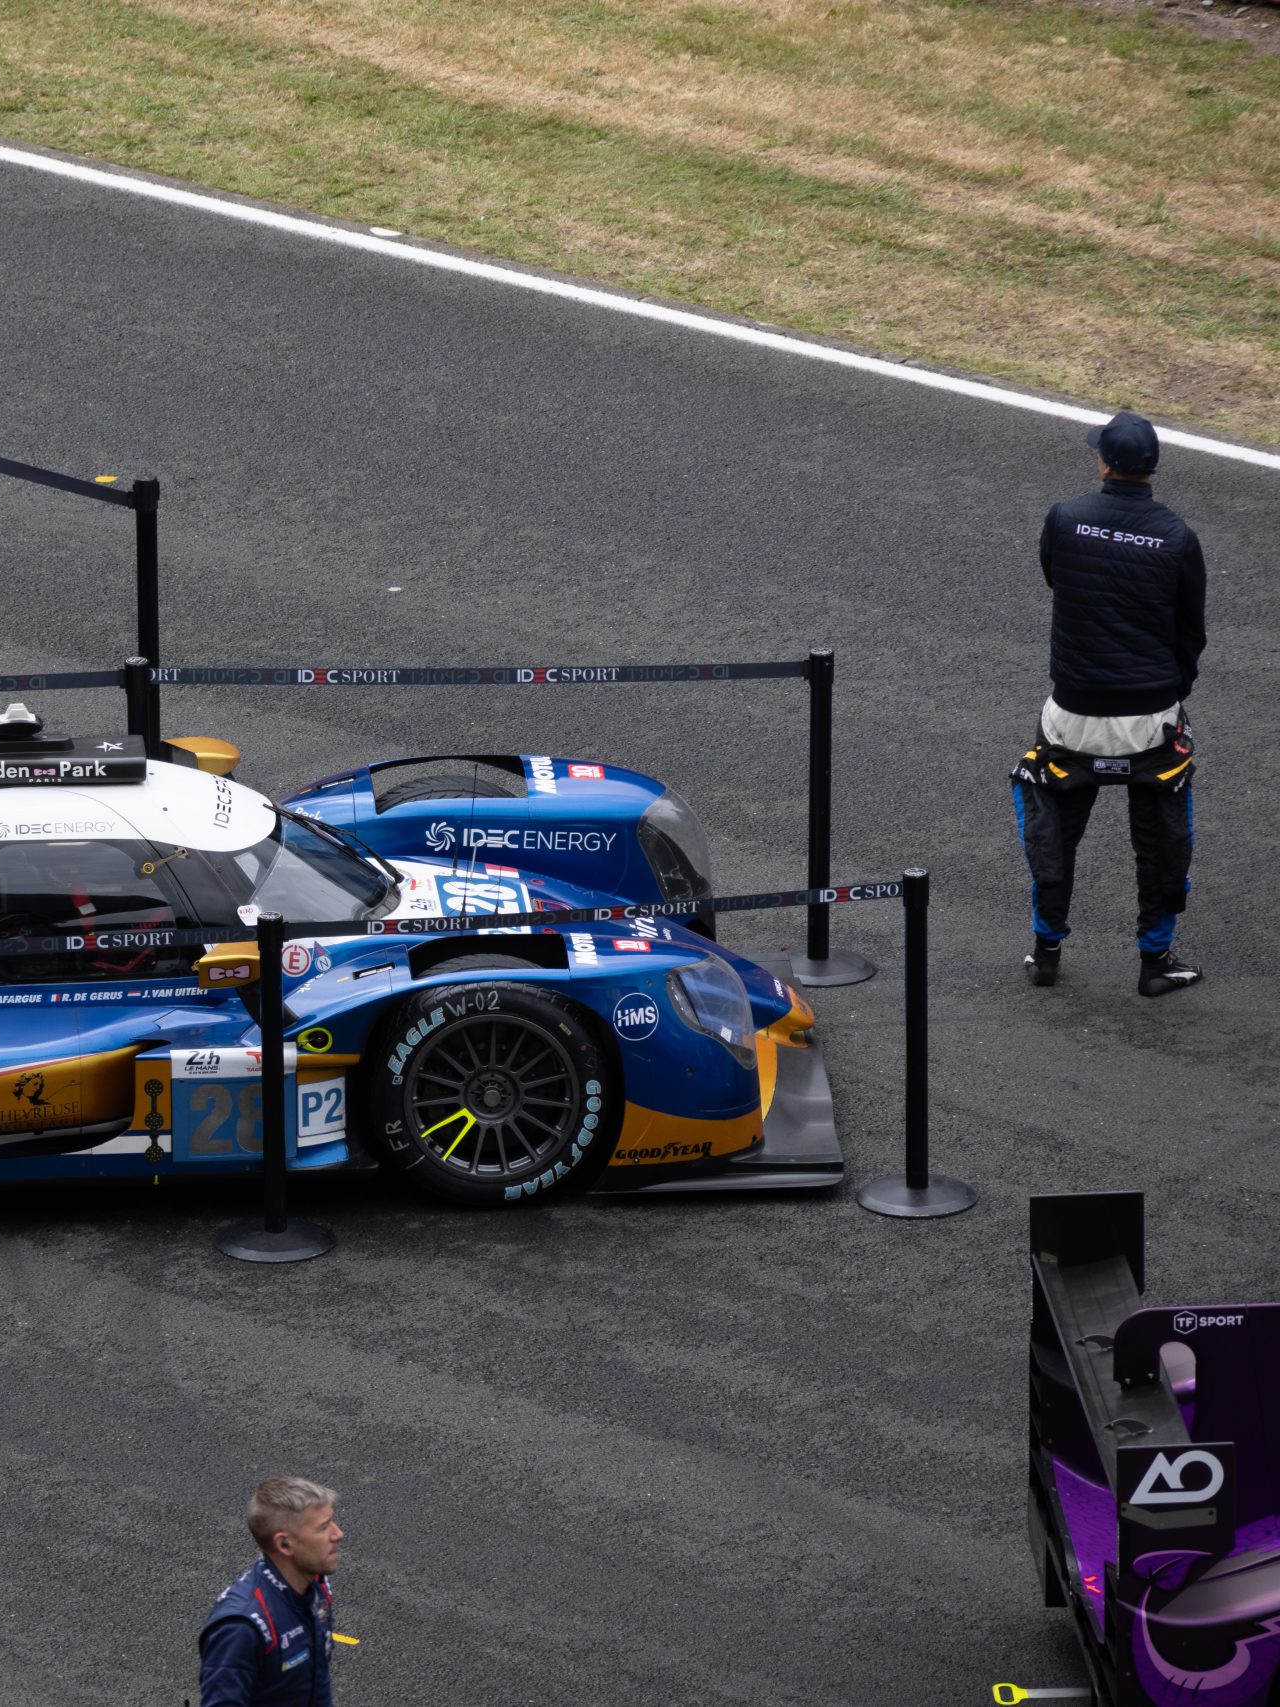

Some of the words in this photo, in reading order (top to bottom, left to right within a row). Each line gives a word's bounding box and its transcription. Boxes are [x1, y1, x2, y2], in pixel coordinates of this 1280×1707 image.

[297, 669, 339, 684] IDEC
[341, 669, 400, 684] SPORT
[517, 668, 558, 683] IDEC
[561, 667, 620, 682] SPORT
[59, 760, 108, 778] Park
[819, 886, 862, 903] IDEC
[864, 882, 904, 899] SPO
[593, 906, 636, 921] IDEC
[639, 901, 700, 917] SPORT
[367, 919, 410, 934] IDEC
[412, 917, 475, 933] SPORT
[66, 934, 109, 950] IDEC
[112, 931, 174, 947] SPORT
[89, 991, 123, 1001] GERUS
[617, 1006, 657, 1027] HMS
[387, 1006, 446, 1076] EAGLE
[301, 1087, 344, 1128] P2
[1177, 1317, 1194, 1328] TF
[1199, 1315, 1244, 1327] SPORT
